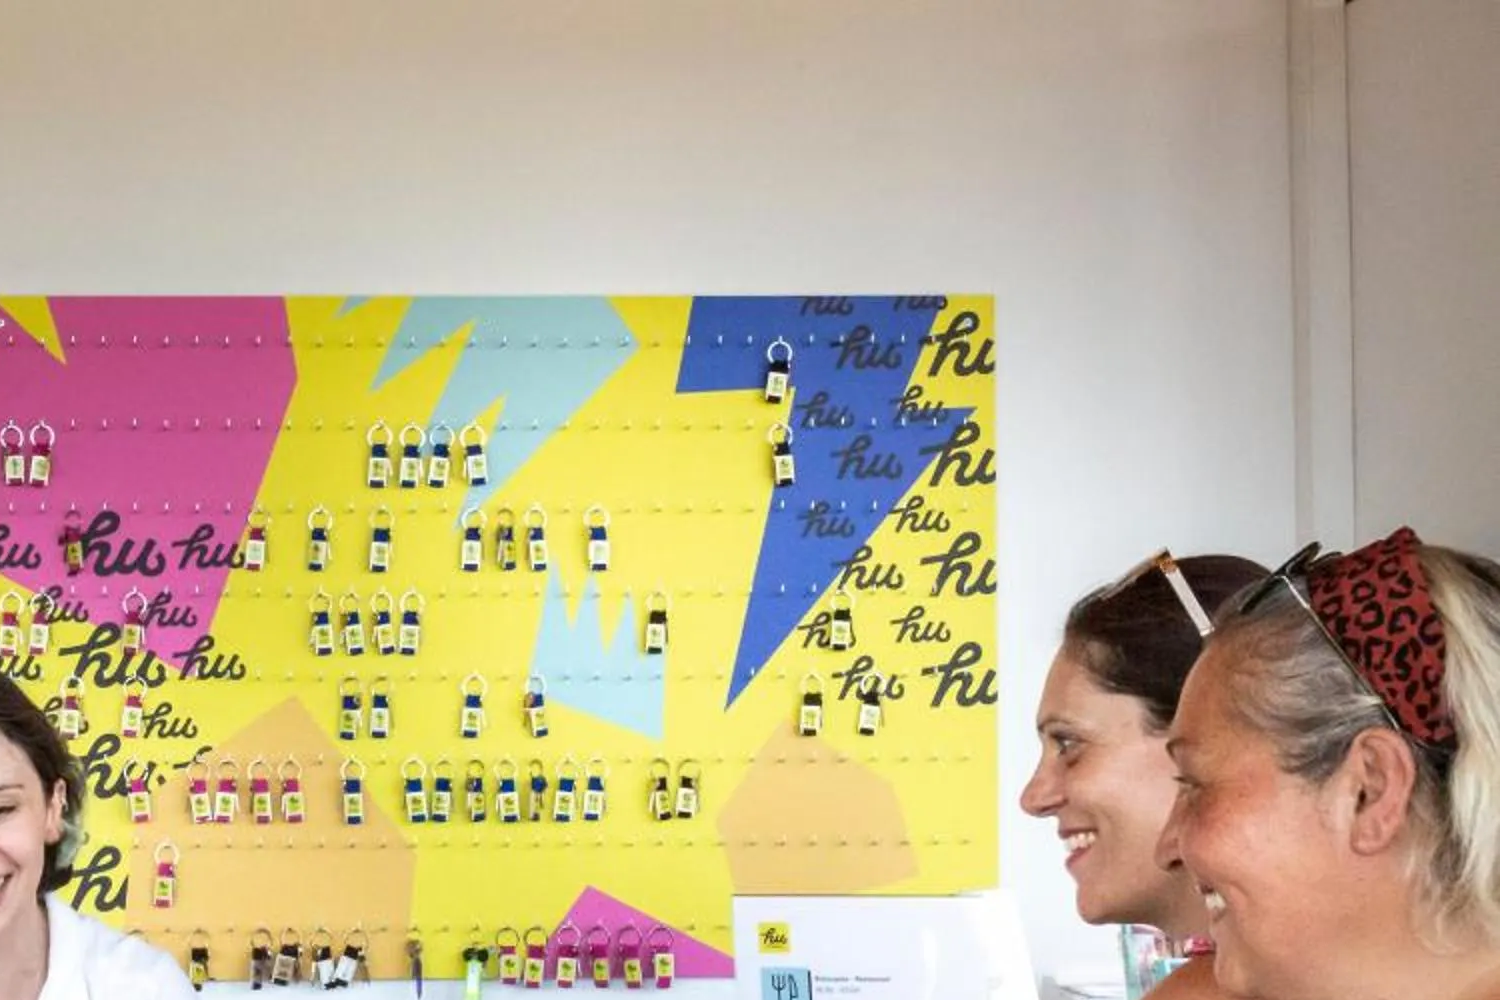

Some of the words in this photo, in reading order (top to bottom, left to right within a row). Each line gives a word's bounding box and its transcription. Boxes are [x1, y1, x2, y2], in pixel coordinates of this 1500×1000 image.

[830, 325, 902, 370] hu
[796, 391, 854, 428] hu
[830, 434, 903, 480] hu
[889, 495, 950, 533] hu
[171, 524, 246, 569] hu
[831, 545, 904, 590] hu
[797, 611, 856, 649] h
[890, 606, 951, 643] hu
[59, 622, 167, 688] hu
[172, 635, 246, 681] hu
[141, 702, 198, 738] hu
